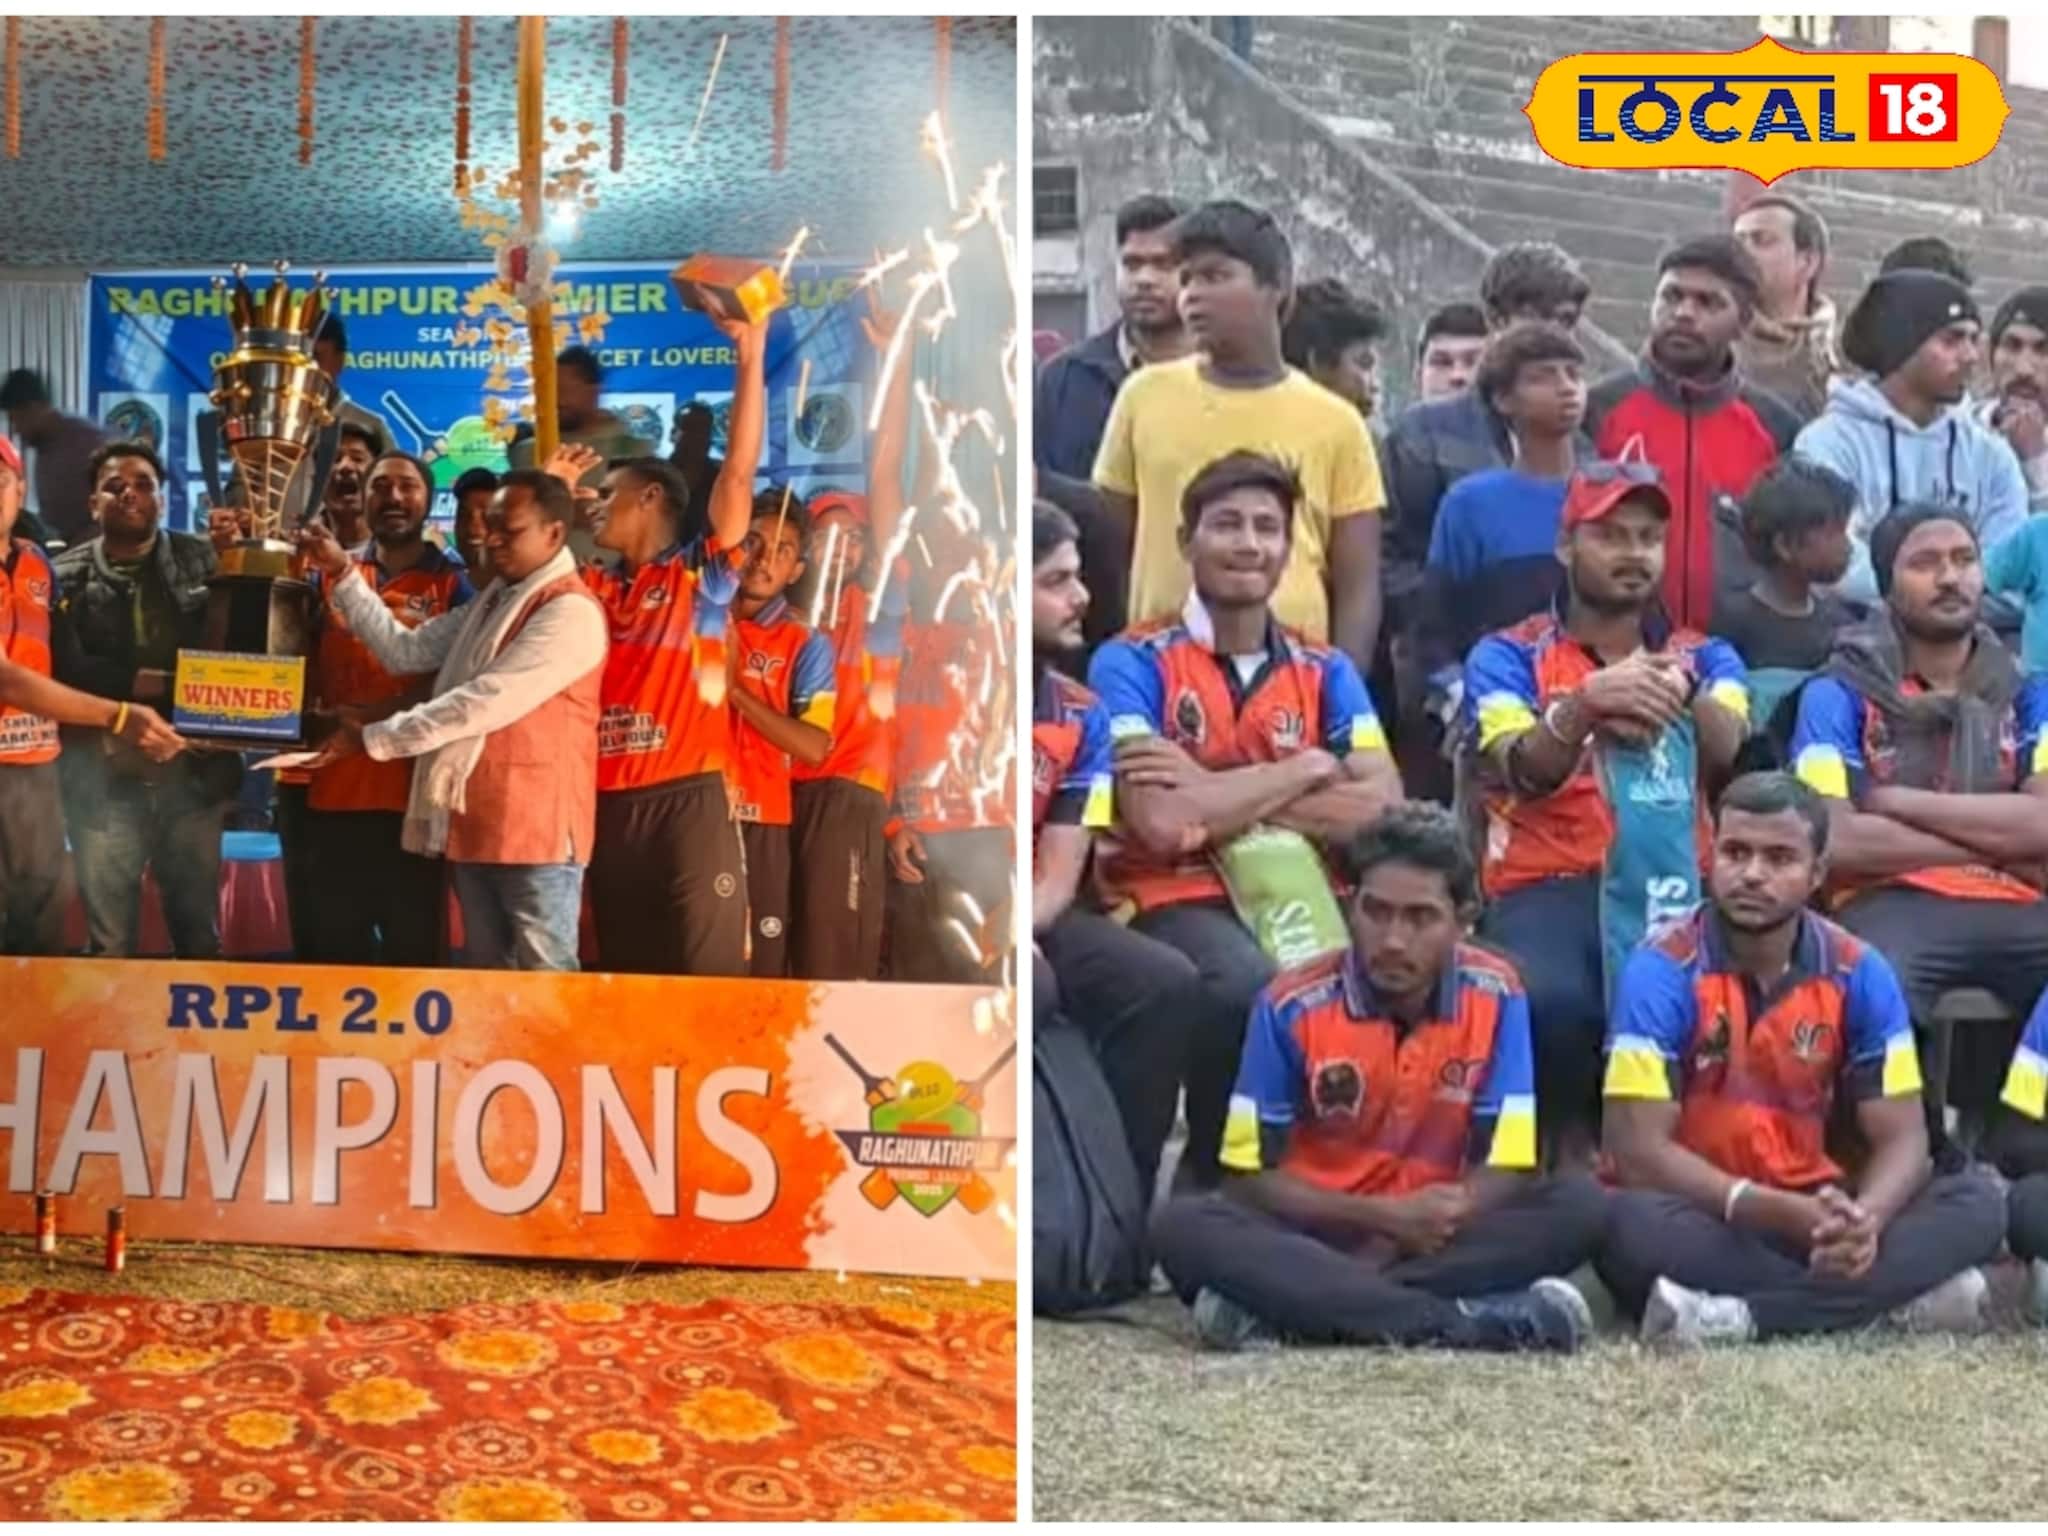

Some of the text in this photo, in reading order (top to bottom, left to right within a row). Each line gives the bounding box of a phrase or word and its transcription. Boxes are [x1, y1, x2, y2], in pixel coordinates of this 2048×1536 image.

[107, 286, 459, 316] RAGHHPUR
[182, 683, 293, 711] WINNERS
[167, 984, 453, 1035] RPL 2.0
[858, 1136, 996, 1170] RAGHUNATHP
